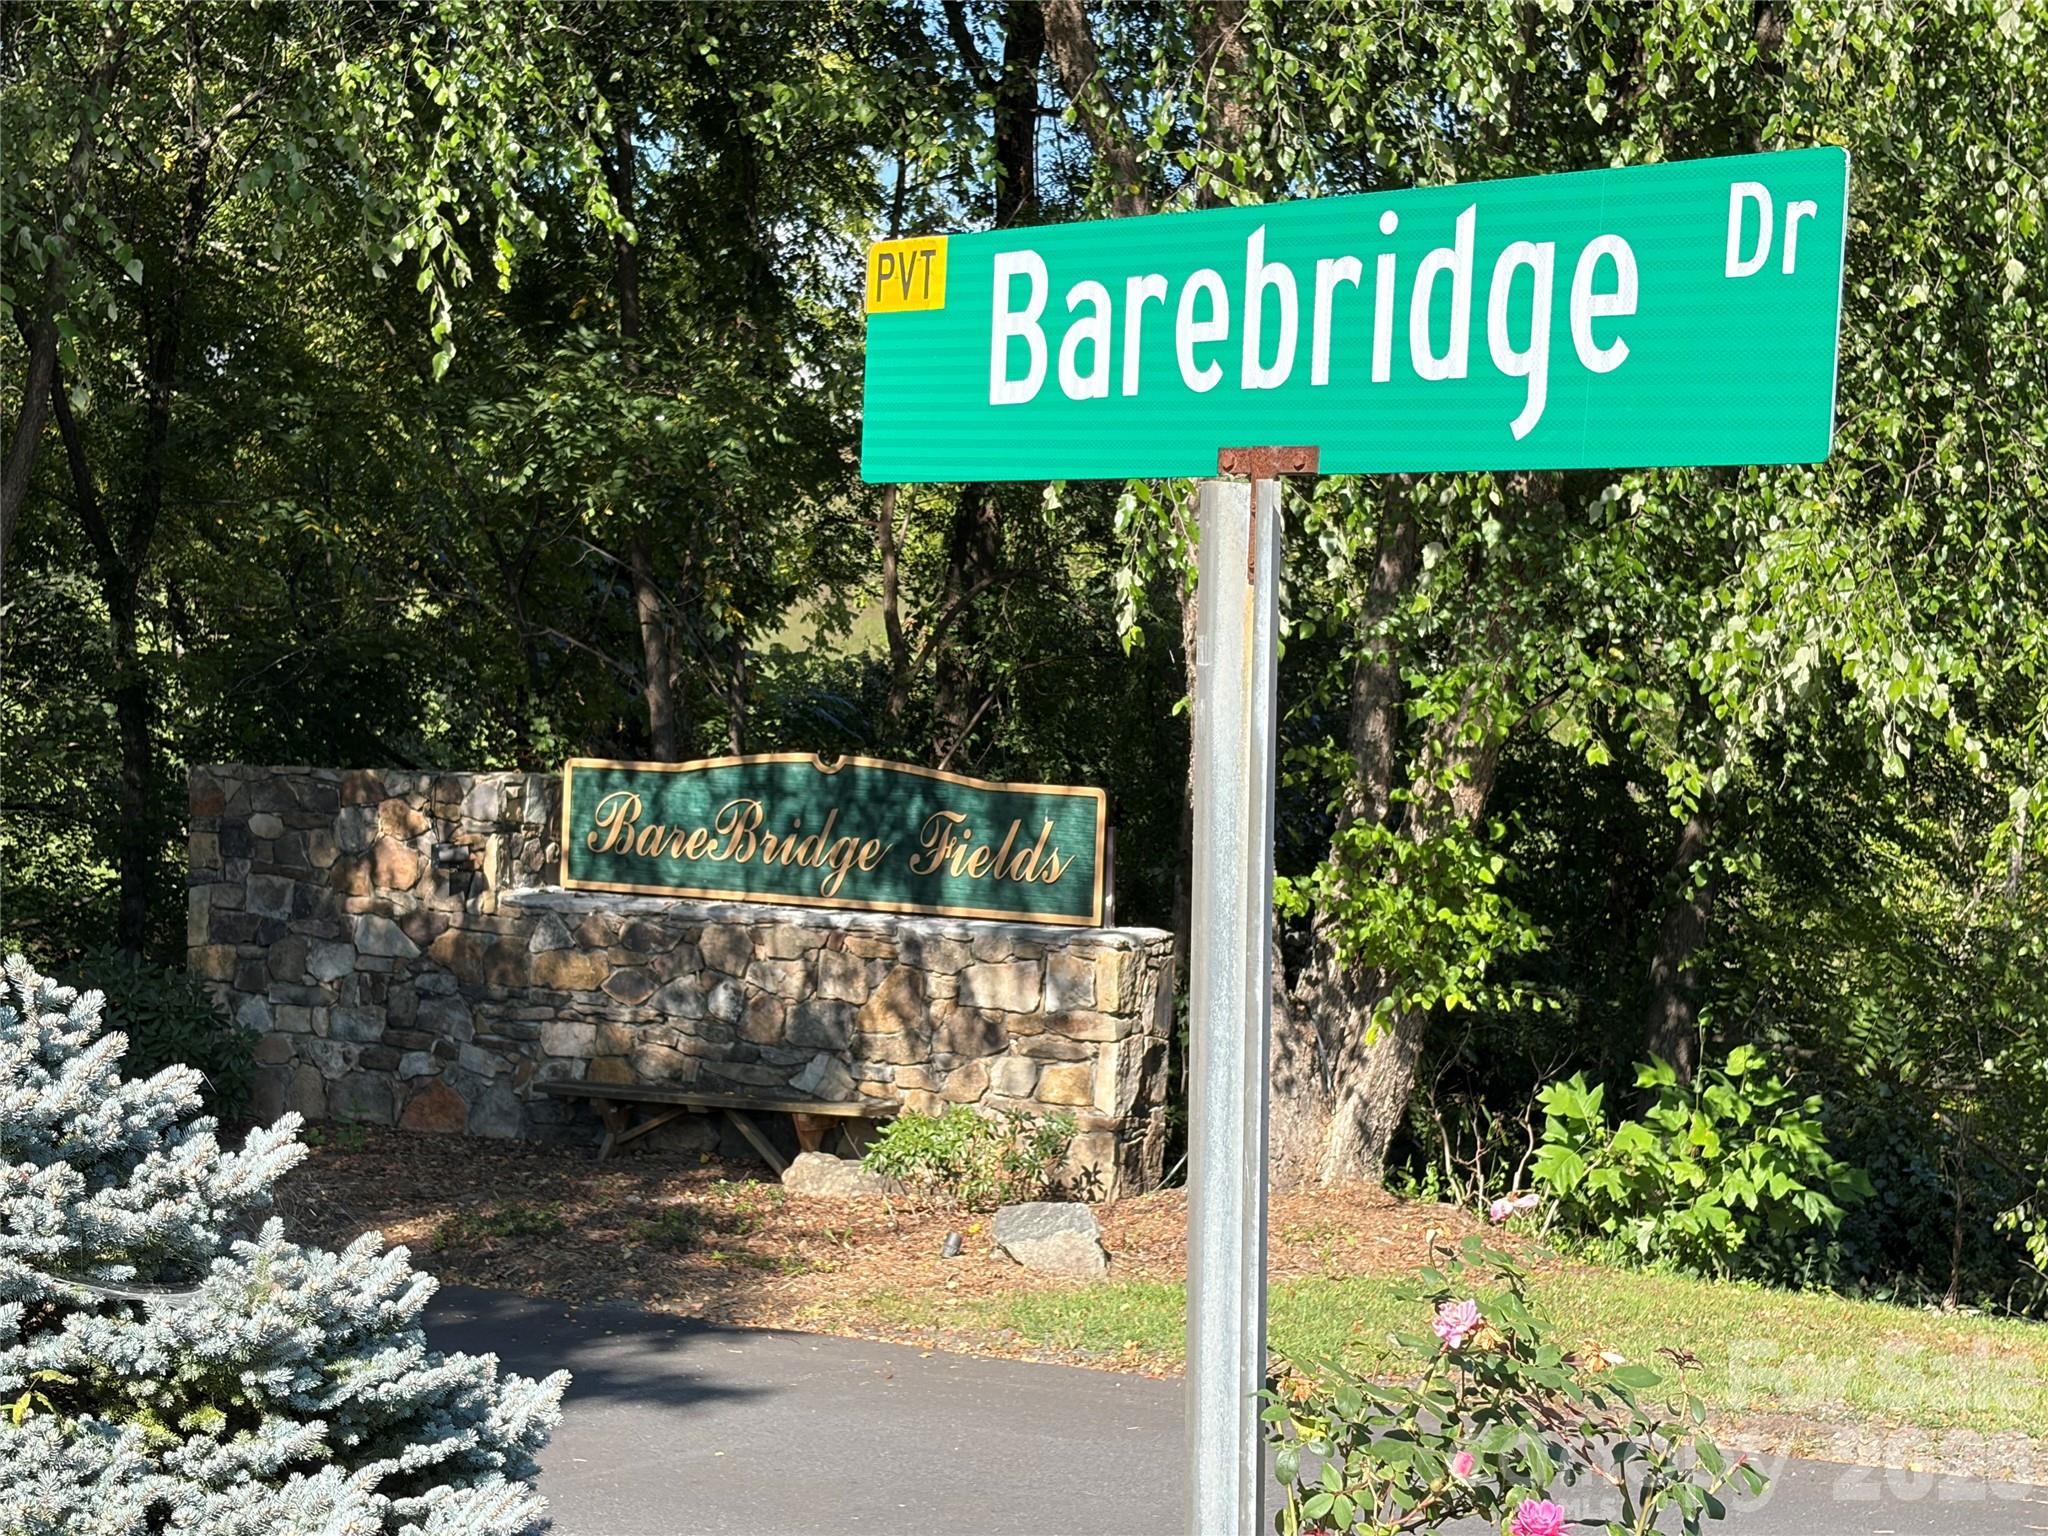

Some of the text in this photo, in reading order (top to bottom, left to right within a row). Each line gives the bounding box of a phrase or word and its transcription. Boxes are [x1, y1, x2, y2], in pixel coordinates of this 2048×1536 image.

[875, 248, 937, 303] PVT
[988, 181, 1818, 441] Barebridge Dr
[586, 790, 1076, 899] BareBridge Fields
